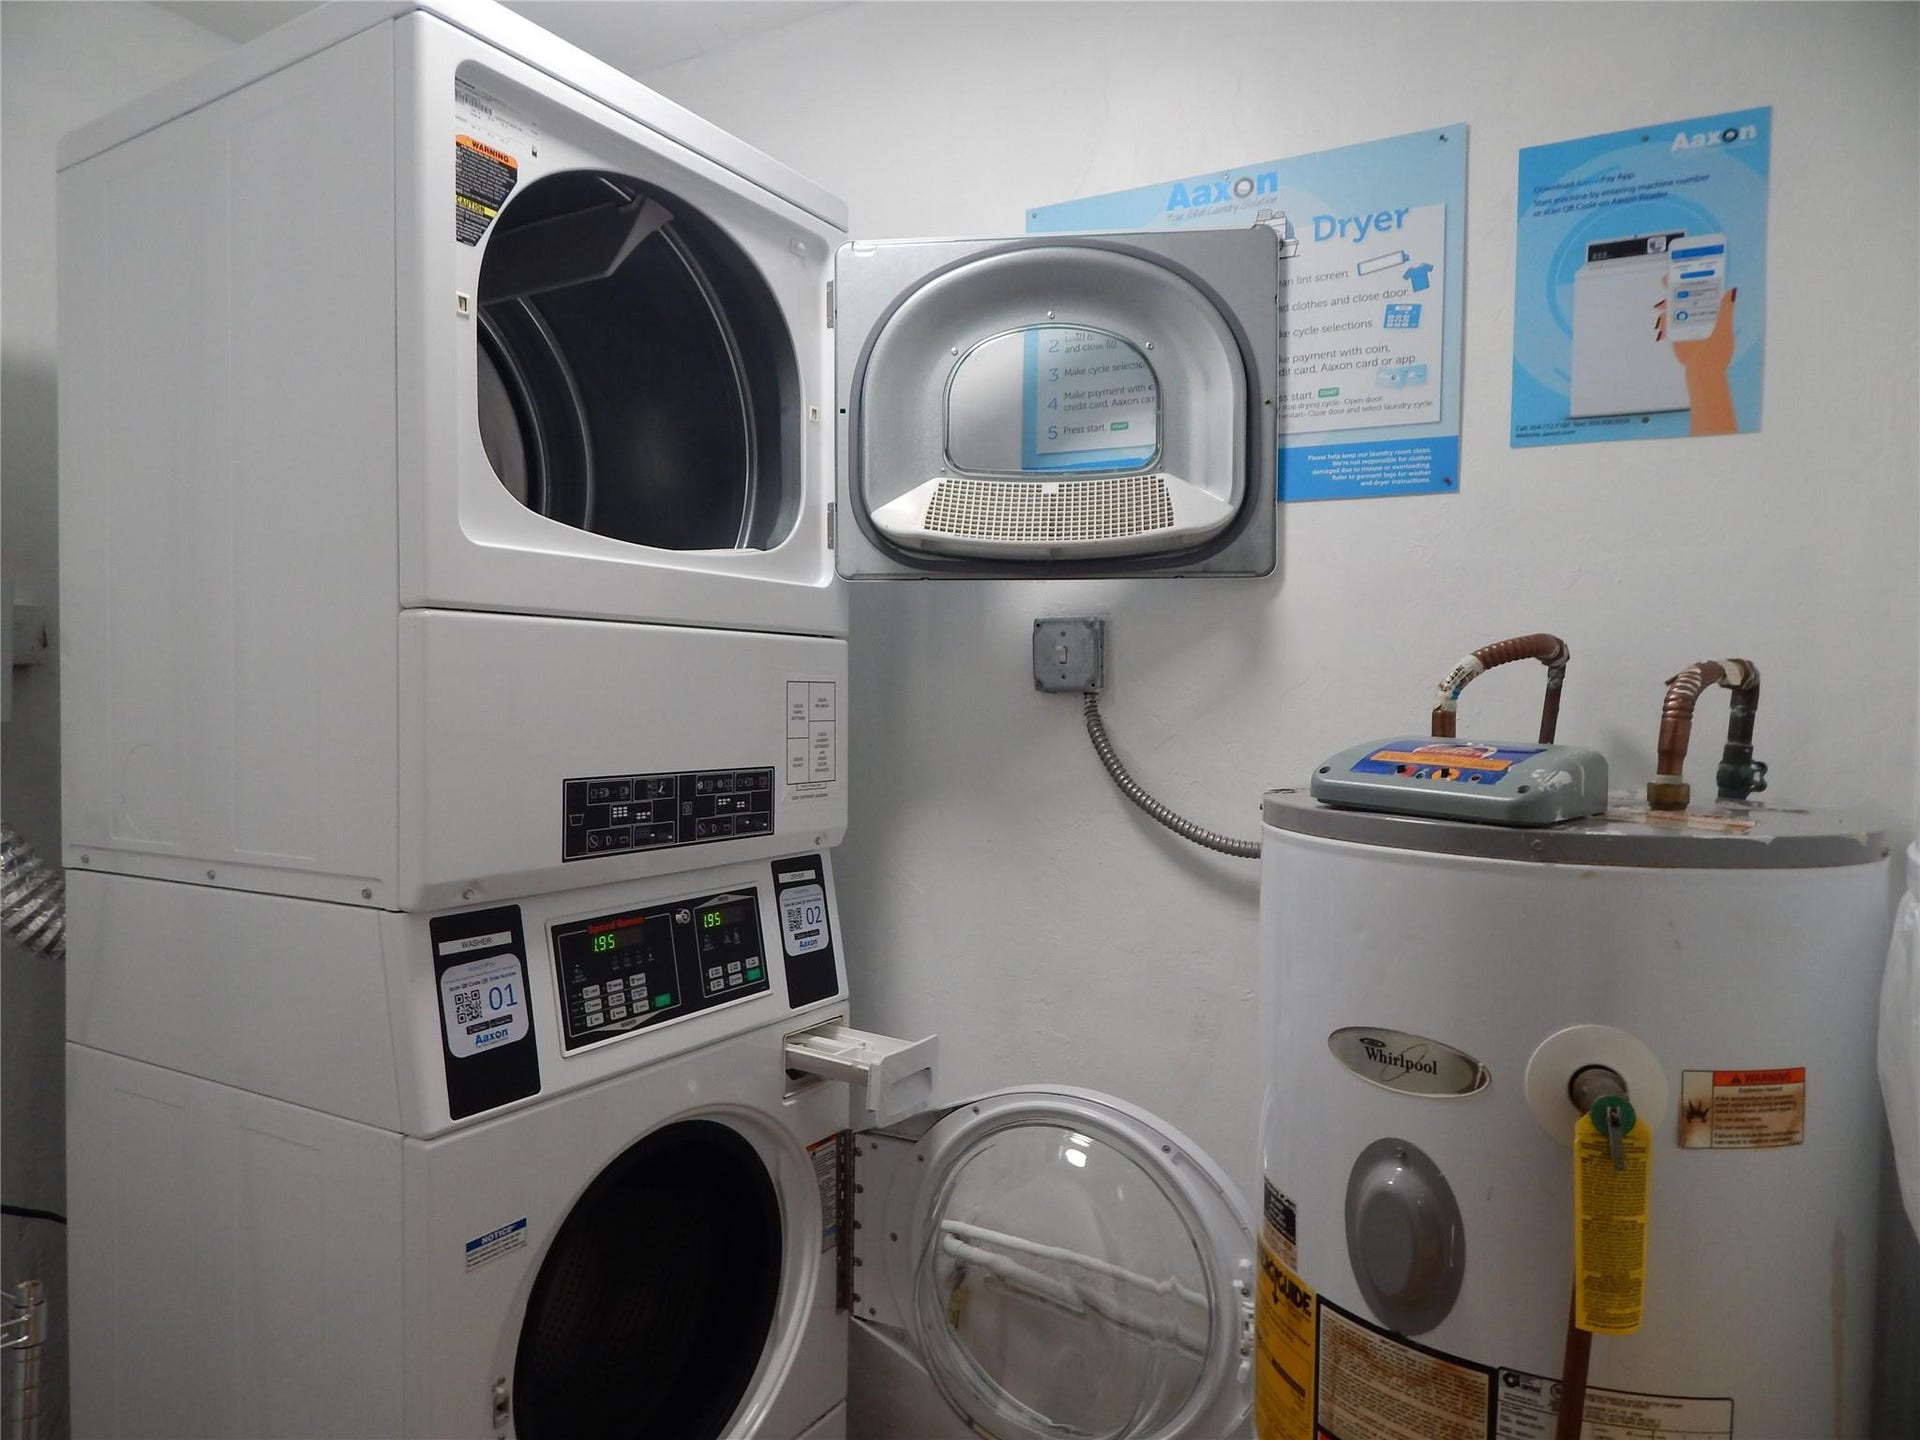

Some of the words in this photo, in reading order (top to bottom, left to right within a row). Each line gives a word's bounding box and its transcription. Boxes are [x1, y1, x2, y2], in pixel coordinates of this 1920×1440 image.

[1670, 123, 1757, 152] Aaxon
[472, 140, 510, 163] WARNING
[1166, 170, 1278, 211] Aaxon
[1637, 179, 1674, 191] machine
[1675, 174, 1711, 185] number
[1313, 207, 1410, 243] Dryer
[1292, 298, 1329, 313] clothes
[1331, 295, 1350, 306] and
[1352, 291, 1379, 304] close
[1293, 325, 1319, 339] cycle
[1321, 319, 1374, 334] selections
[1292, 350, 1337, 365] payment
[1339, 346, 1363, 357] with
[1049, 368, 1060, 382] 3
[1064, 367, 1086, 377] Make
[1088, 364, 1110, 376] cycle
[1111, 361, 1146, 372] selectio
[1320, 362, 1353, 373] Aaxon
[1356, 357, 1379, 369] card
[1382, 357, 1393, 366] or
[1064, 390, 1086, 401] Make
[1088, 387, 1125, 401] payment
[1127, 384, 1147, 396] with
[1344, 396, 1364, 406] Open
[1048, 398, 1058, 411] 4
[1048, 426, 1058, 440] 5
[1063, 426, 1084, 435] Press
[1342, 452, 1357, 460] keep
[1370, 450, 1394, 458] laundry
[1312, 467, 1340, 476] damaged
[1356, 472, 1382, 481] garment
[1374, 478, 1391, 487] dryer
[806, 905, 822, 925] 02
[461, 936, 492, 949] WASHER
[488, 983, 518, 1011] 01
[475, 1028, 509, 1045] Aaxon
[1364, 1045, 1438, 1076] Whirlpool
[1744, 1071, 1793, 1083] WARNING
[481, 1225, 516, 1245] NOTICE
